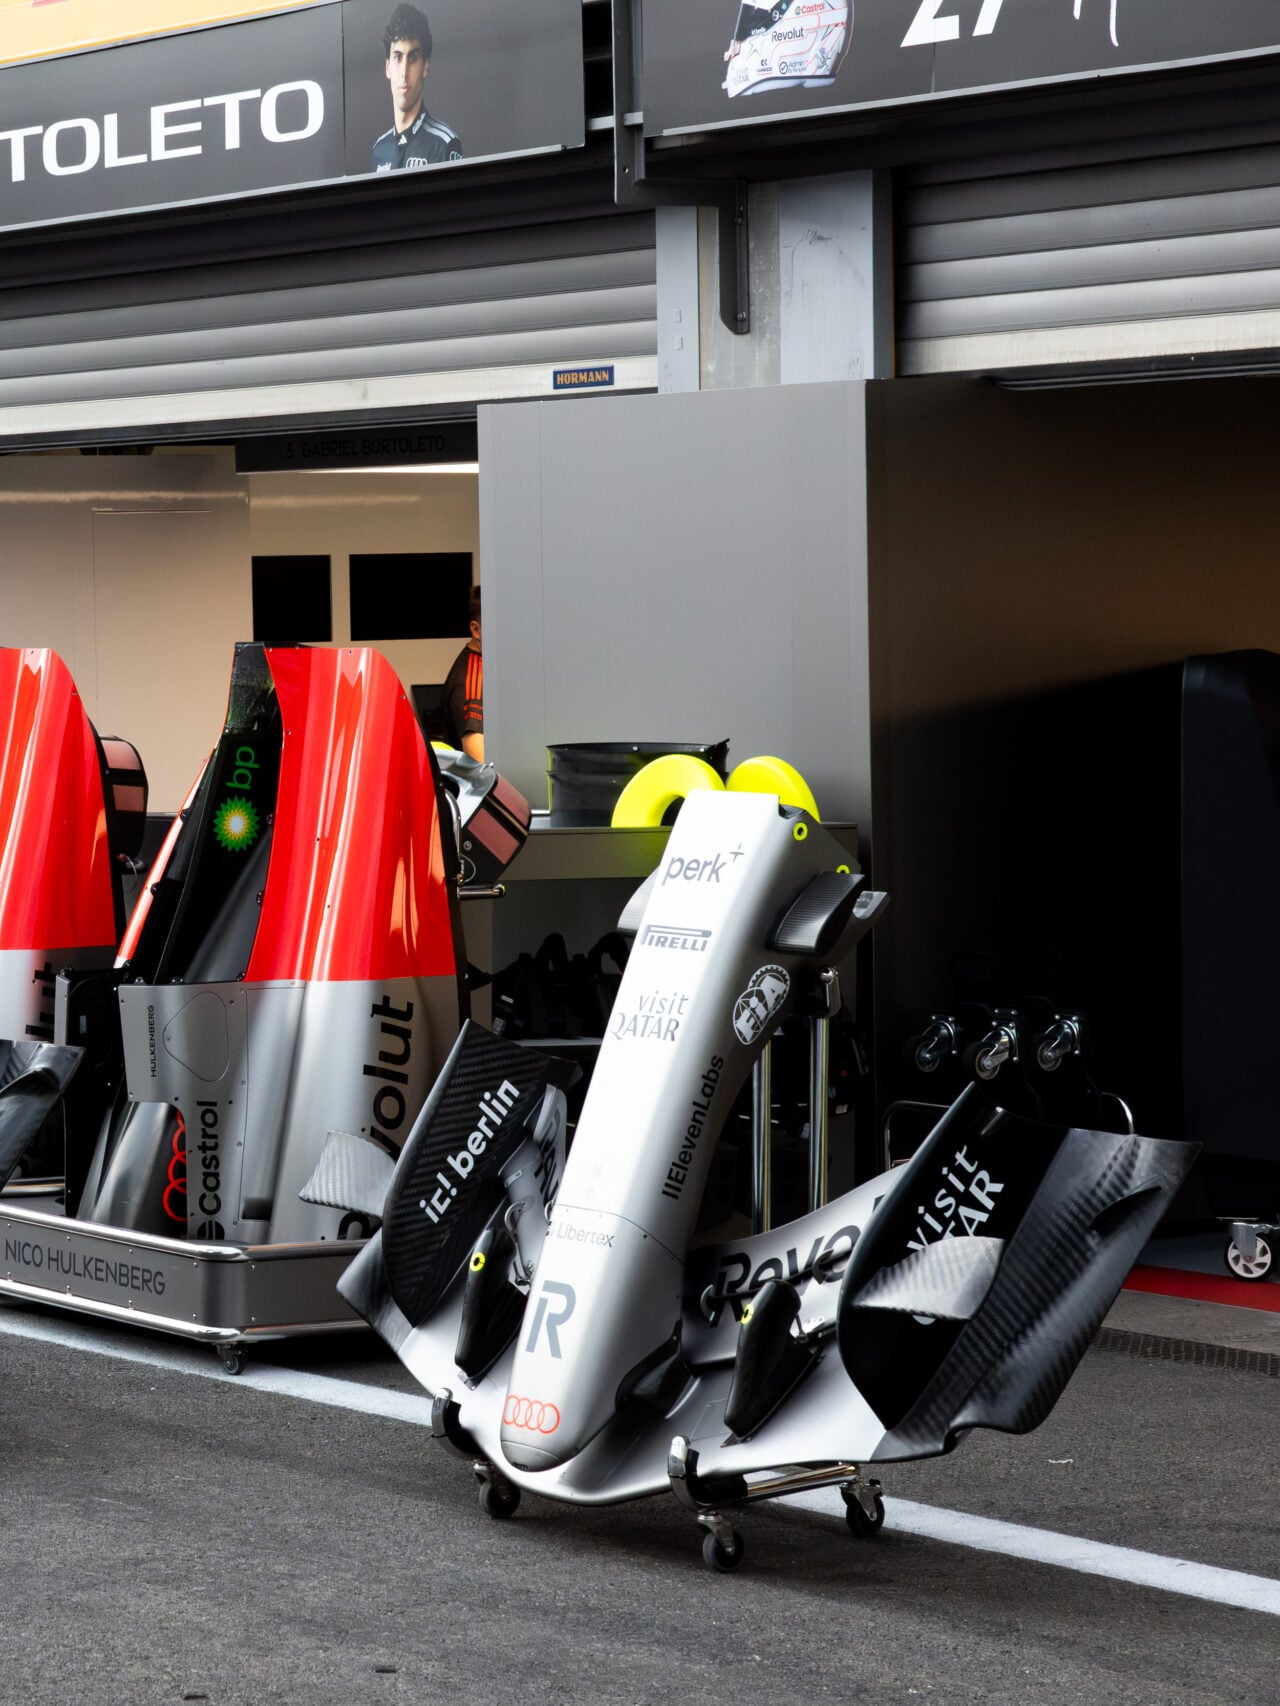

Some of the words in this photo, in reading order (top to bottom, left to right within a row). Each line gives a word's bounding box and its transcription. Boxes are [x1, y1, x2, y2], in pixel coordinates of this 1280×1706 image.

[771, 27, 804, 42] Revolut
[362, 435, 446, 455] BORTOLETO
[226, 745, 259, 790] bp
[640, 924, 712, 952] PIRELLI
[638, 990, 688, 1015] visit
[736, 976, 788, 1044] FIA
[149, 1004, 157, 1078] HULKENBERG
[612, 1012, 680, 1042] QATAR
[419, 1172, 457, 1224] ic!
[446, 1079, 520, 1180] berlin
[906, 1145, 978, 1251] visit
[556, 1222, 615, 1248] Libertex
[5, 1240, 44, 1267] NICO
[47, 1248, 166, 1296] HULKENBERG
[525, 1280, 576, 1359] R
